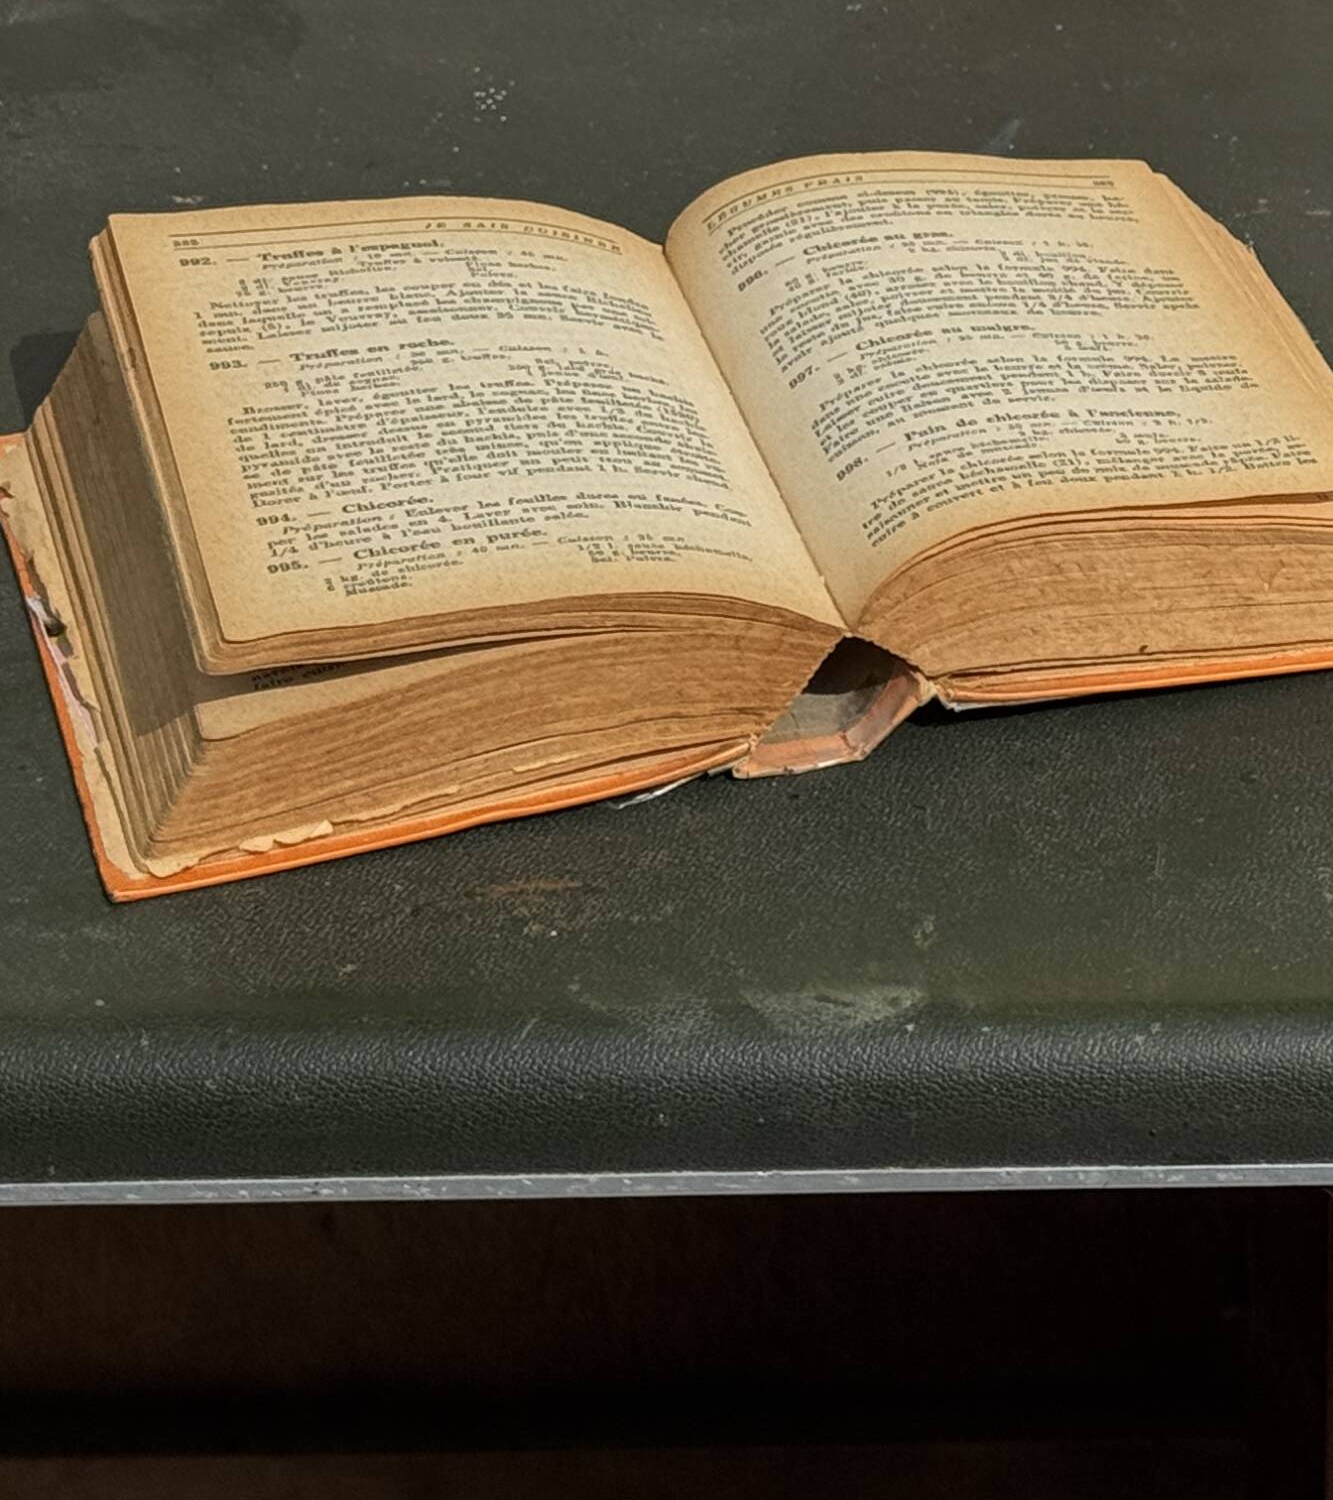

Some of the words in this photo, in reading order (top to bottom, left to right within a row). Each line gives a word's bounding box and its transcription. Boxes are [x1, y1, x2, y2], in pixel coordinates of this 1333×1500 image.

[179, 257, 218, 267] 992.
[256, 250, 324, 261] Truffes
[802, 236, 878, 256] Chicorée
[209, 359, 248, 370] 993.
[289, 348, 360, 362] Truffes
[367, 345, 390, 353] en
[398, 338, 456, 351] roche.
[855, 329, 933, 351] Chicorée
[903, 425, 948, 442] Pain
[955, 418, 978, 428] de
[985, 409, 1061, 423] chicorée
[256, 513, 298, 526] 994.
[341, 495, 434, 514] Chicorée.
[282, 516, 383, 535] Préparation
[404, 504, 469, 518] Enlever
[477, 500, 501, 509] les
[508, 493, 568, 506] feuilles
[305, 532, 328, 541] les
[339, 523, 398, 537] salades
[464, 509, 511, 521] Laver
[521, 505, 557, 513] avec
[266, 560, 309, 574] 995.
[352, 539, 441, 560] Chicorée
[452, 537, 476, 545] en
[486, 528, 548, 544] purée.
[271, 546, 299, 558] 1/4
